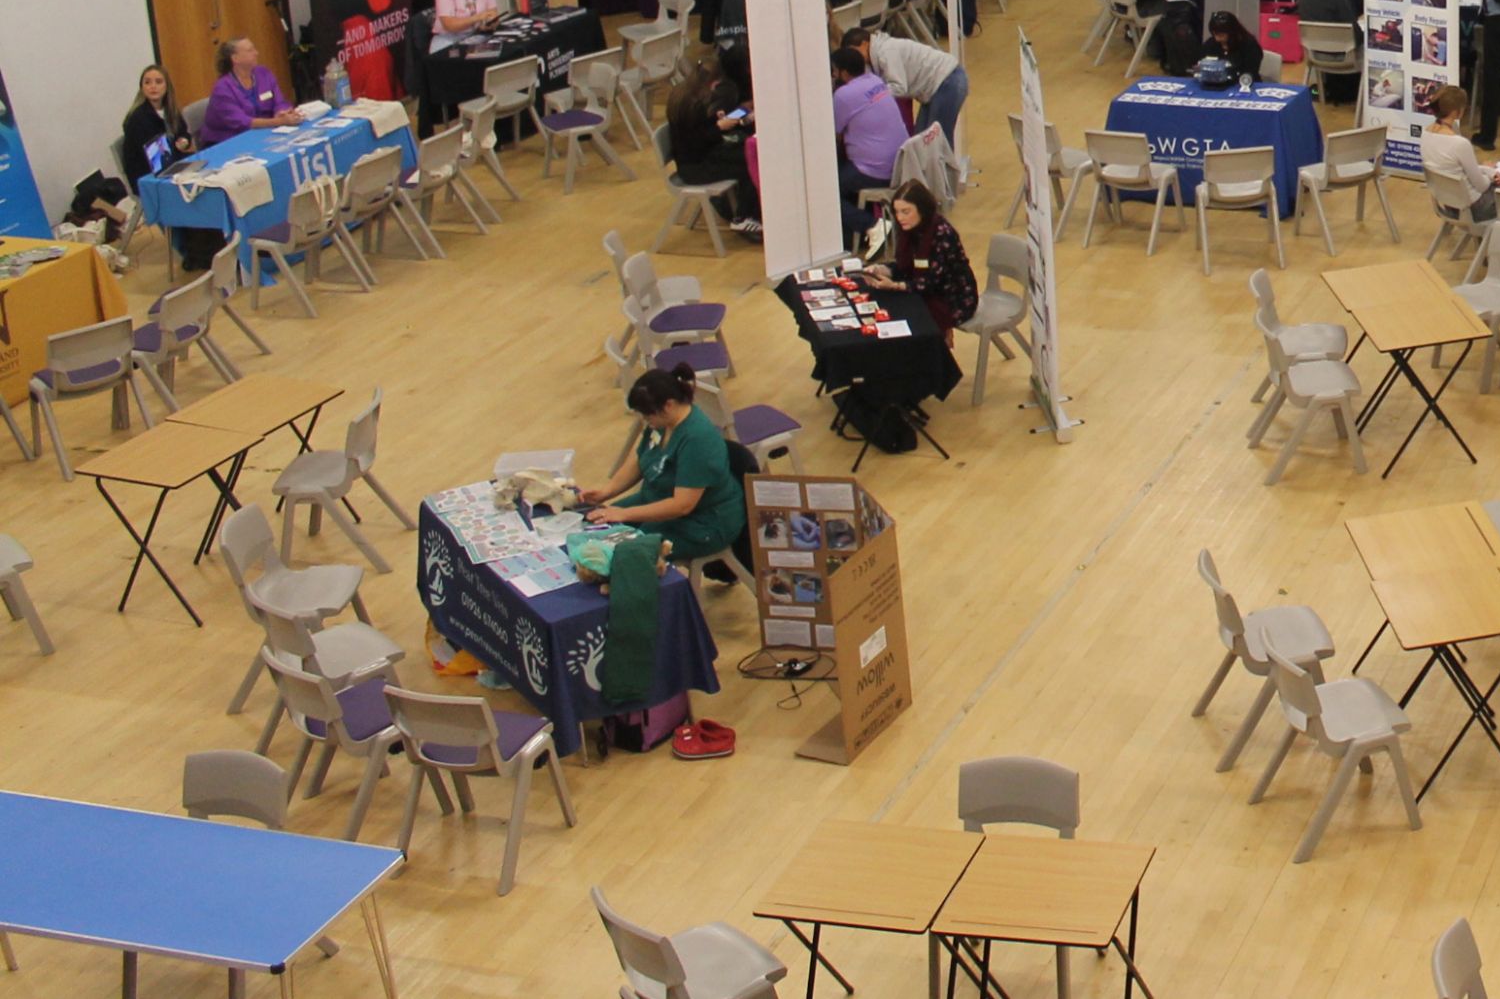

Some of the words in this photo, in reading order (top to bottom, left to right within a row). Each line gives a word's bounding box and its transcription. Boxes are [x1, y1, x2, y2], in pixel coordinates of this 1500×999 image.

[368, 7, 410, 36] MAKERS
[1414, 14, 1428, 23] Body
[1429, 16, 1447, 25] Repair
[338, 46, 352, 64] OF
[1433, 72, 1448, 82] Parts
[1157, 136, 1233, 156] WGTA
[855, 651, 895, 695] willow
